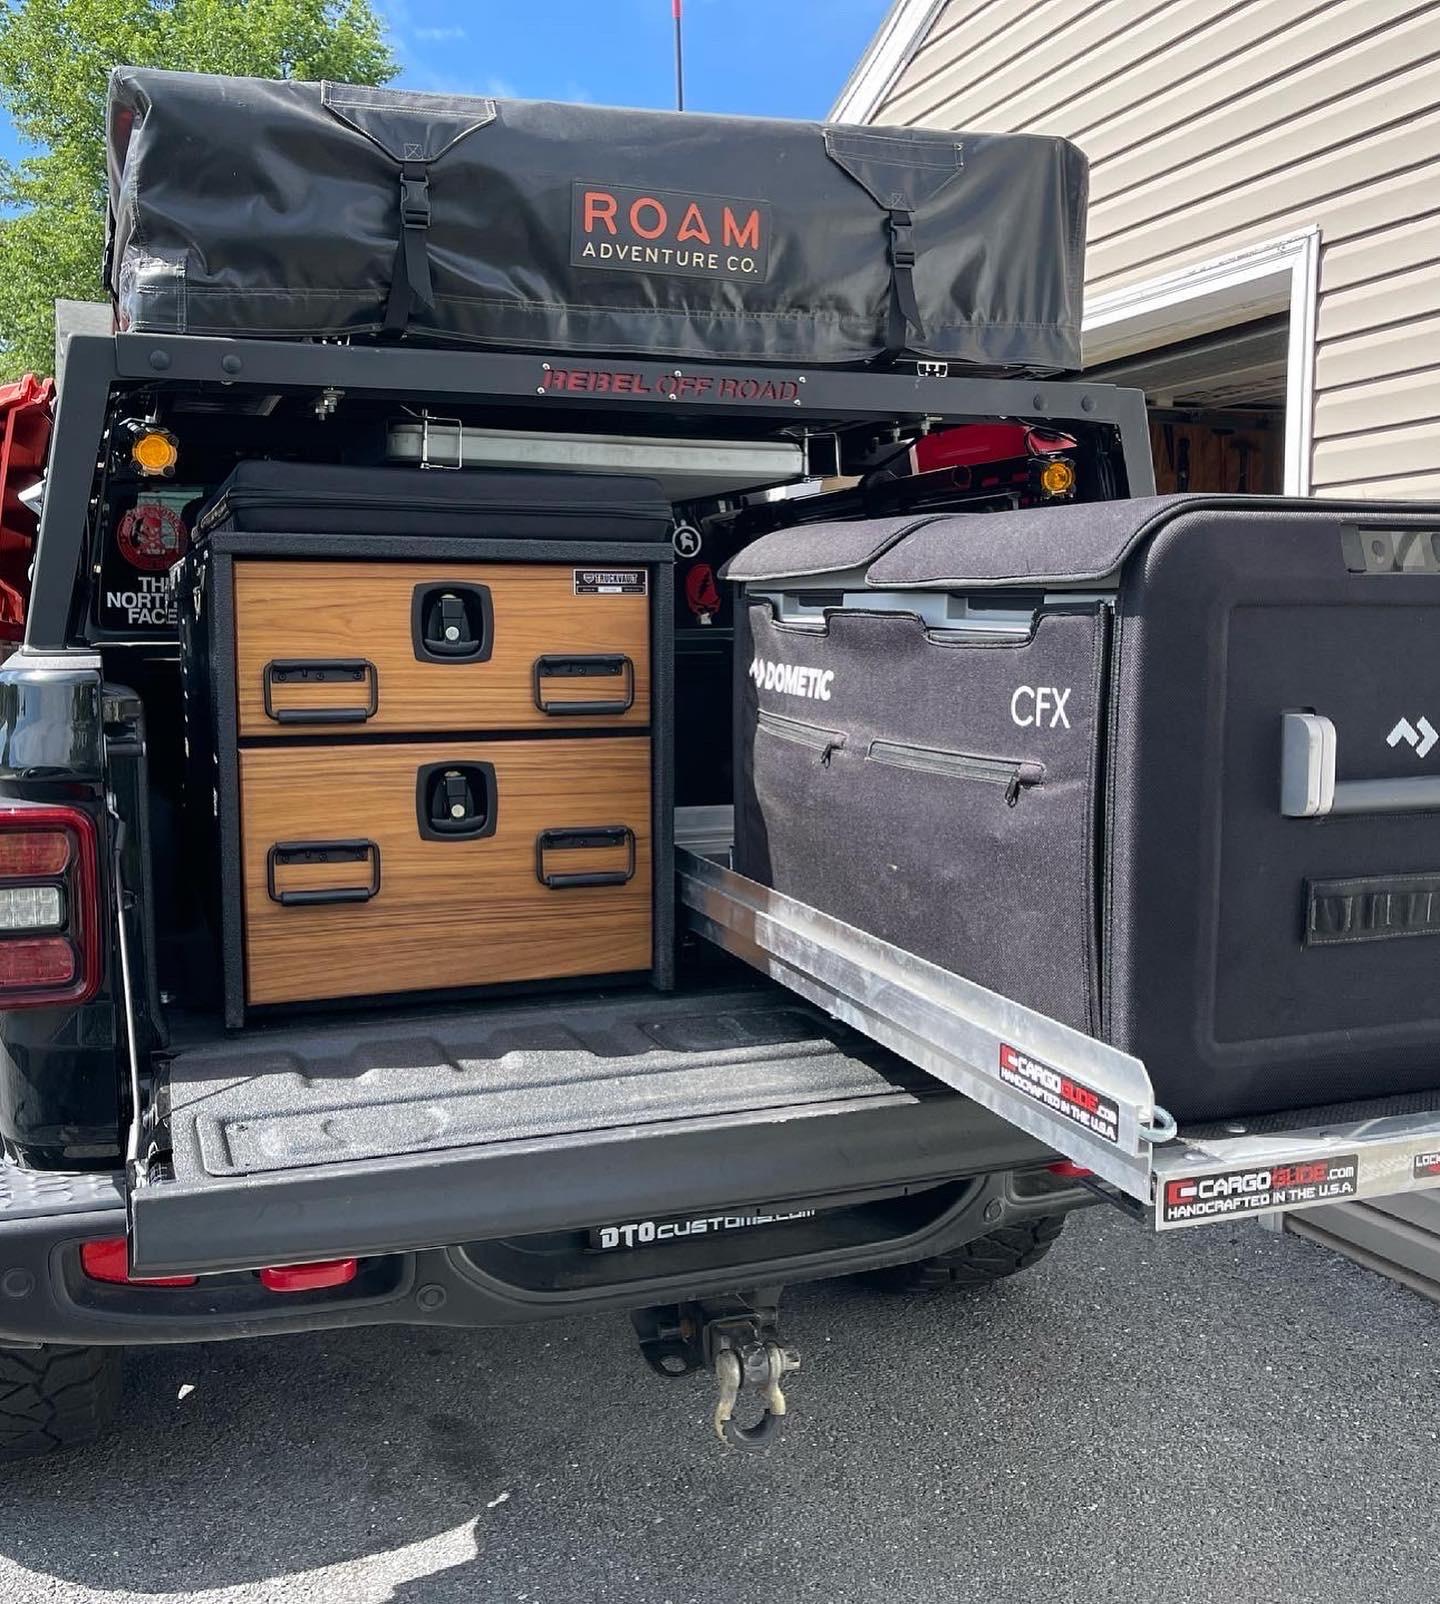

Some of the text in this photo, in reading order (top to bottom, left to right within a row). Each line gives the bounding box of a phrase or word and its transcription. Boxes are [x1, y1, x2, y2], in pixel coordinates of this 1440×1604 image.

[584, 191, 760, 250] ROAM
[582, 241, 758, 273] ADVENTURE CO.
[543, 368, 799, 400] REBEL OFF ROAD
[128, 608, 178, 624] FACE
[764, 660, 835, 701] DOMETIC
[1010, 685, 1072, 729] CFX
[1001, 1067, 1060, 1109] HANDCRAFTED
[1060, 1102, 1071, 1116] IN
[1071, 1104, 1091, 1127] THE
[1167, 1181, 1354, 1220] HANDCRAFTED IN THE U.S.A.
